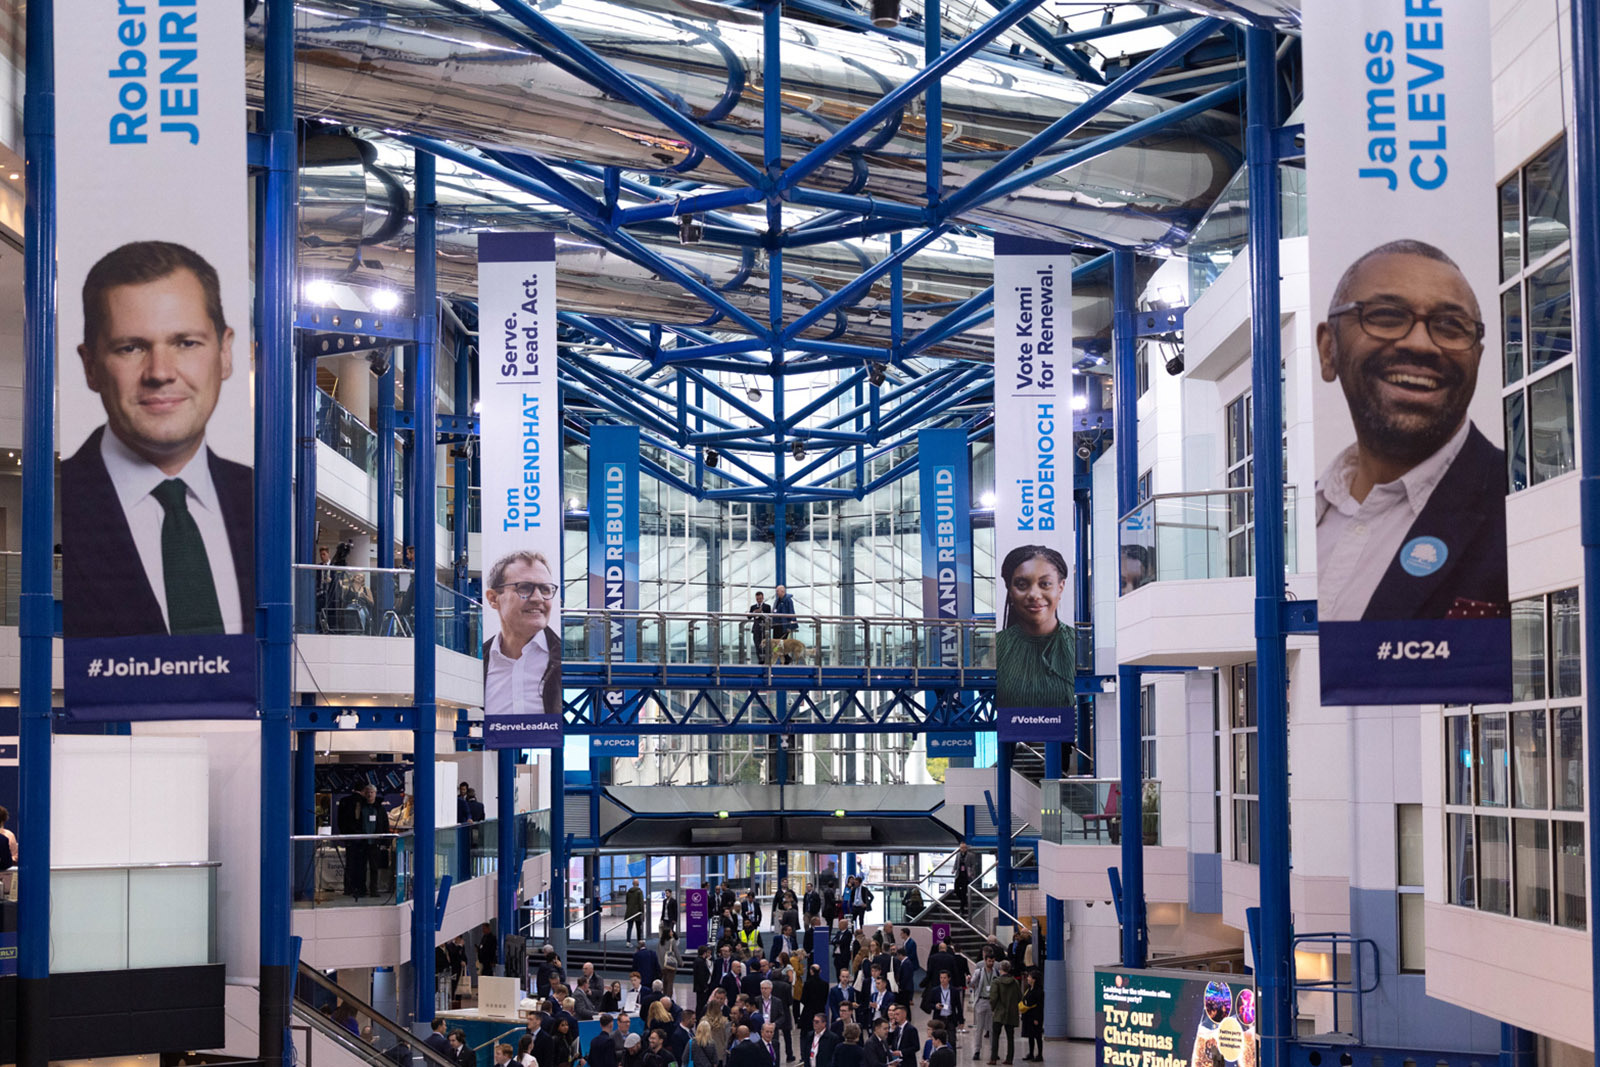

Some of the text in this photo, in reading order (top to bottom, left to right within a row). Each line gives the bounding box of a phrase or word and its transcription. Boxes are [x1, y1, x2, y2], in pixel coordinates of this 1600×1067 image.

[1359, 30, 1398, 191] James
[502, 312, 517, 376] Serve.
[522, 274, 538, 375] Lead. Act.
[1015, 286, 1033, 389] Vote Kemi
[1037, 263, 1054, 389] for Renewal.
[523, 393, 541, 532] TUGENDHAT
[1038, 403, 1055, 531] BADENOCH
[503, 488, 520, 532] Tom
[606, 466, 624, 560] REBUILD
[936, 469, 955, 562] REBUILD
[1016, 479, 1034, 531] Kemi
[939, 568, 957, 615] AND
[88, 655, 230, 677] #JoinJenrick
[1377, 640, 1450, 660] #JC24
[489, 722, 559, 732] #ServeLeadAct
[603, 738, 635, 747] #CPC24
[941, 738, 973, 747] #CPC24
[1011, 715, 1062, 724] #VoteKemi
[1103, 1004, 1154, 1028] Try our
[1103, 1025, 1173, 1051] Christmas
[1103, 1045, 1188, 1067] Party Finder
